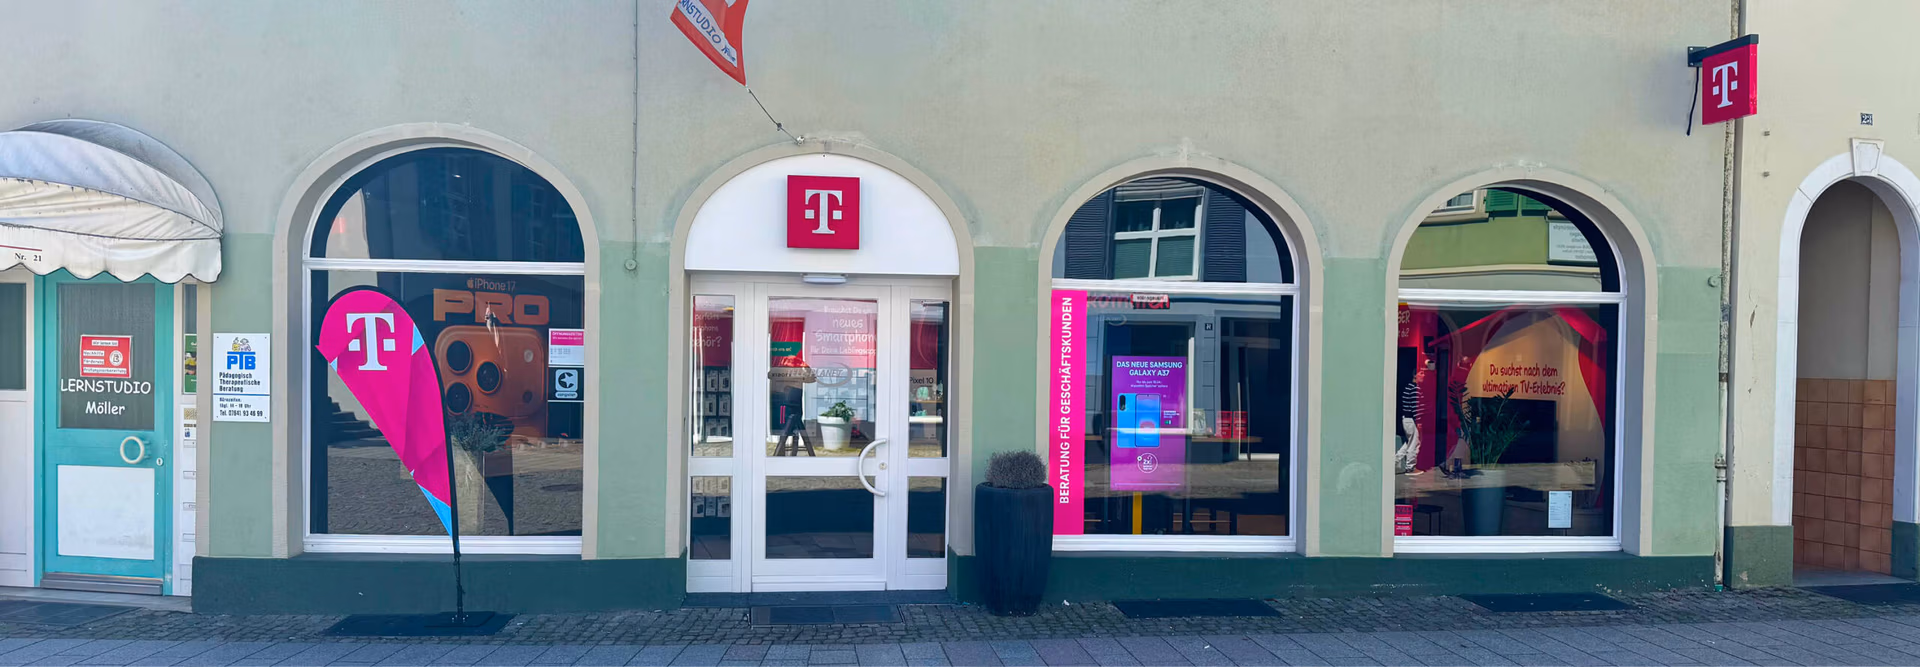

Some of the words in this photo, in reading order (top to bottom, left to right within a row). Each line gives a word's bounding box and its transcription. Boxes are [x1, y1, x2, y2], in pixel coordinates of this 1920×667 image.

[1712, 61, 1738, 108] T
[804, 188, 843, 234] T
[14, 252, 27, 261] Nr.
[33, 254, 42, 262] 21
[474, 278, 506, 291] iPhone
[507, 281, 516, 291] 17
[433, 288, 550, 325] PRO
[832, 318, 863, 329] neues
[346, 312, 396, 371] T
[814, 330, 877, 345] Smartphon
[227, 351, 256, 370] PTB
[1059, 297, 1072, 415] GESCHÄFTSKUNDEN
[1149, 361, 1183, 369] SAMSUNG
[1157, 369, 1170, 377] A37
[1490, 363, 1499, 376] Du
[1500, 362, 1522, 377] suchst
[1523, 362, 1541, 377] nach
[1541, 363, 1558, 377] dem
[60, 379, 151, 394] LERNSTUDIO
[1482, 379, 1519, 394] ultimativen
[1520, 380, 1566, 396] TV-Erlebnis?
[85, 401, 126, 415] Möller
[1058, 415, 1070, 440] FÜR
[1059, 444, 1070, 504] BERATUNG
